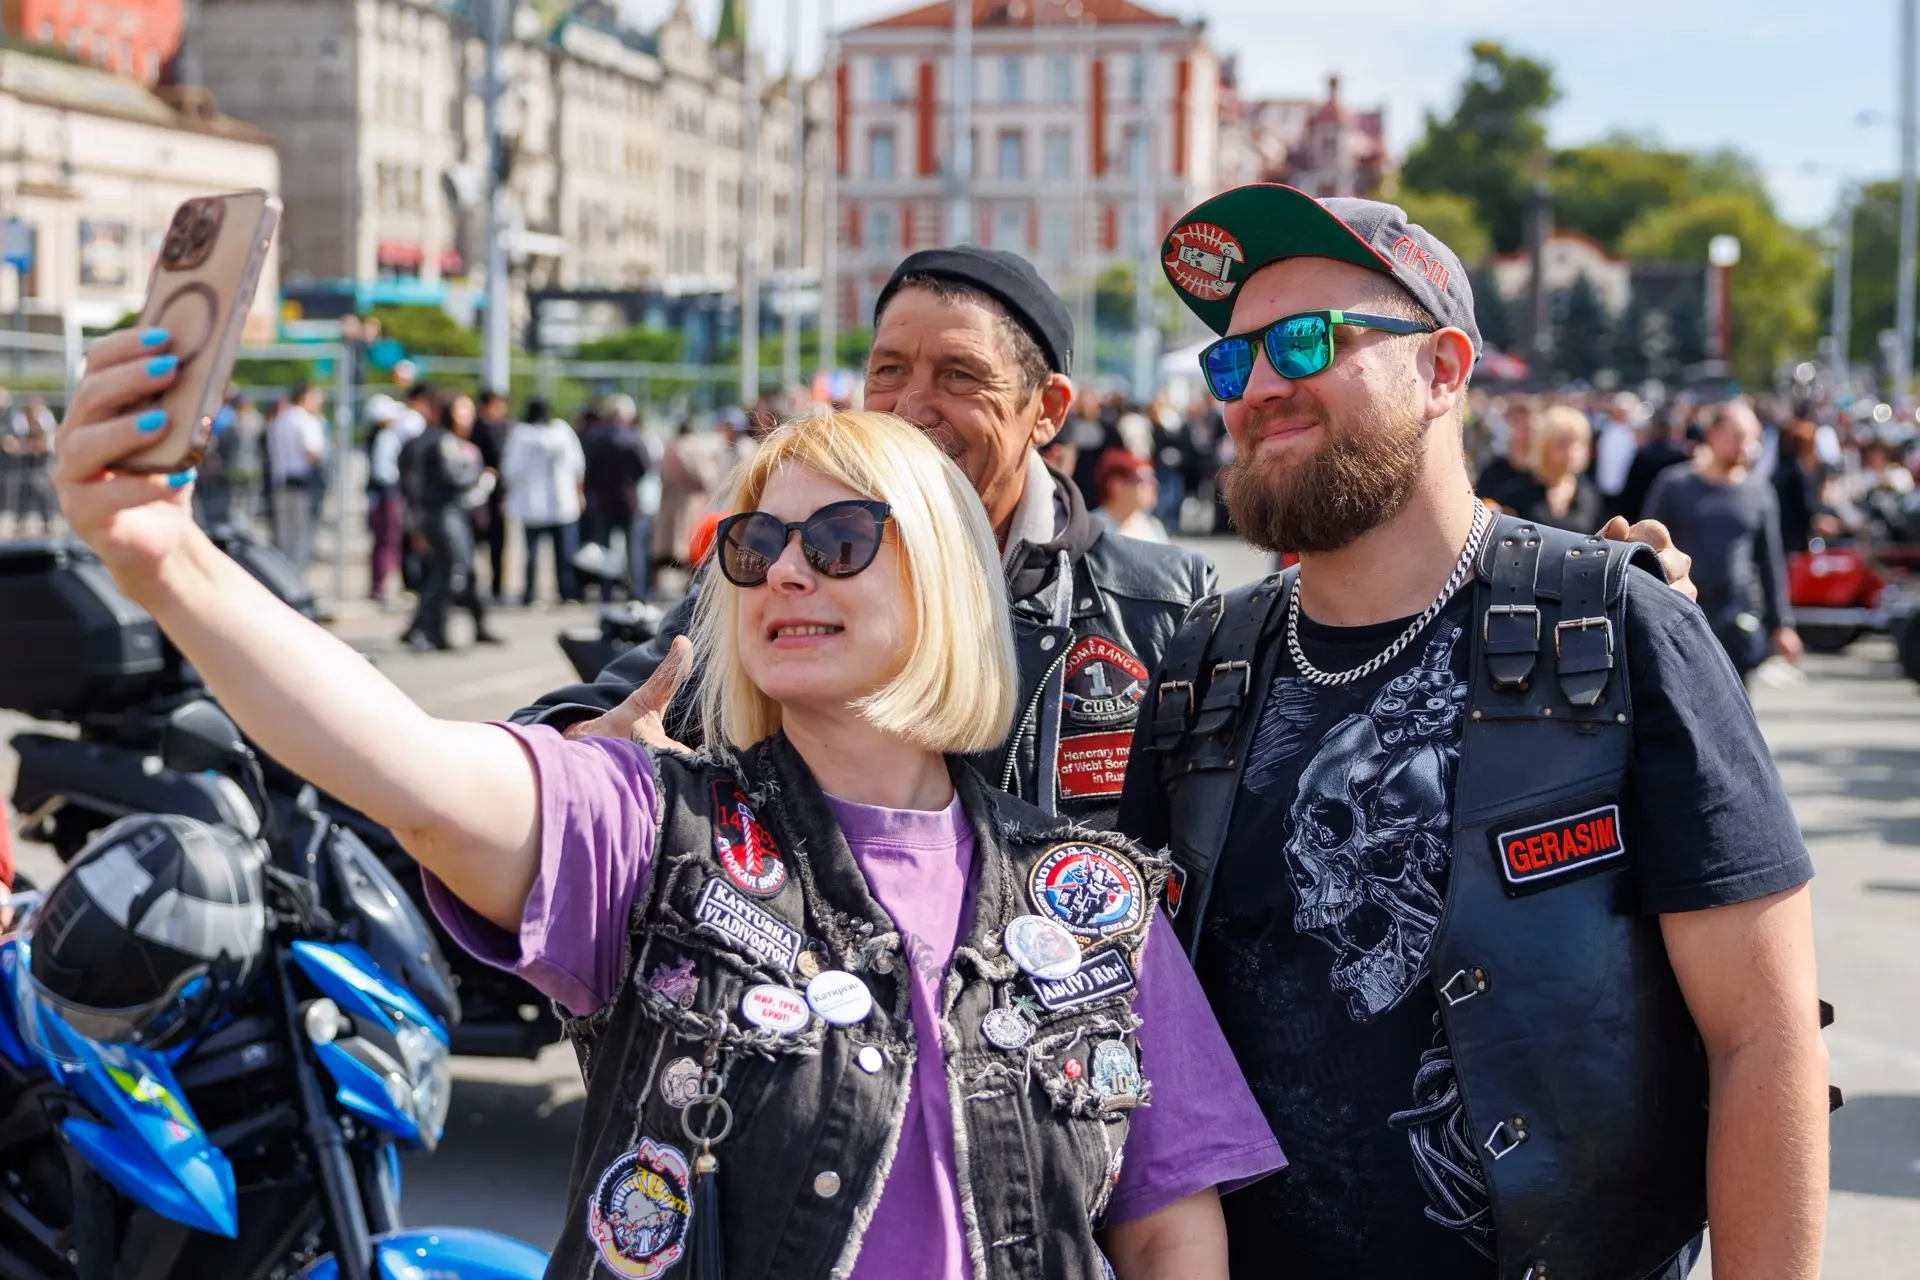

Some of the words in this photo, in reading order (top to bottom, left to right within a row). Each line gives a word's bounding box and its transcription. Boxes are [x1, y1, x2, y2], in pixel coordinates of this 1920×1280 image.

[1065, 640, 1132, 672] OOMERANG
[1085, 662, 1112, 697] 1
[1082, 698, 1127, 713] CUBA
[1104, 759, 1129, 769] Boo
[1092, 772, 1104, 783] in
[1507, 817, 1617, 872] GERASIM
[714, 884, 793, 950] KATYUSHA
[705, 904, 790, 970] VLADIVOSTOK
[1089, 962, 1123, 985] Rh+
[761, 1007, 790, 1023] БРЮТ!
[1110, 1074, 1129, 1095] 10
